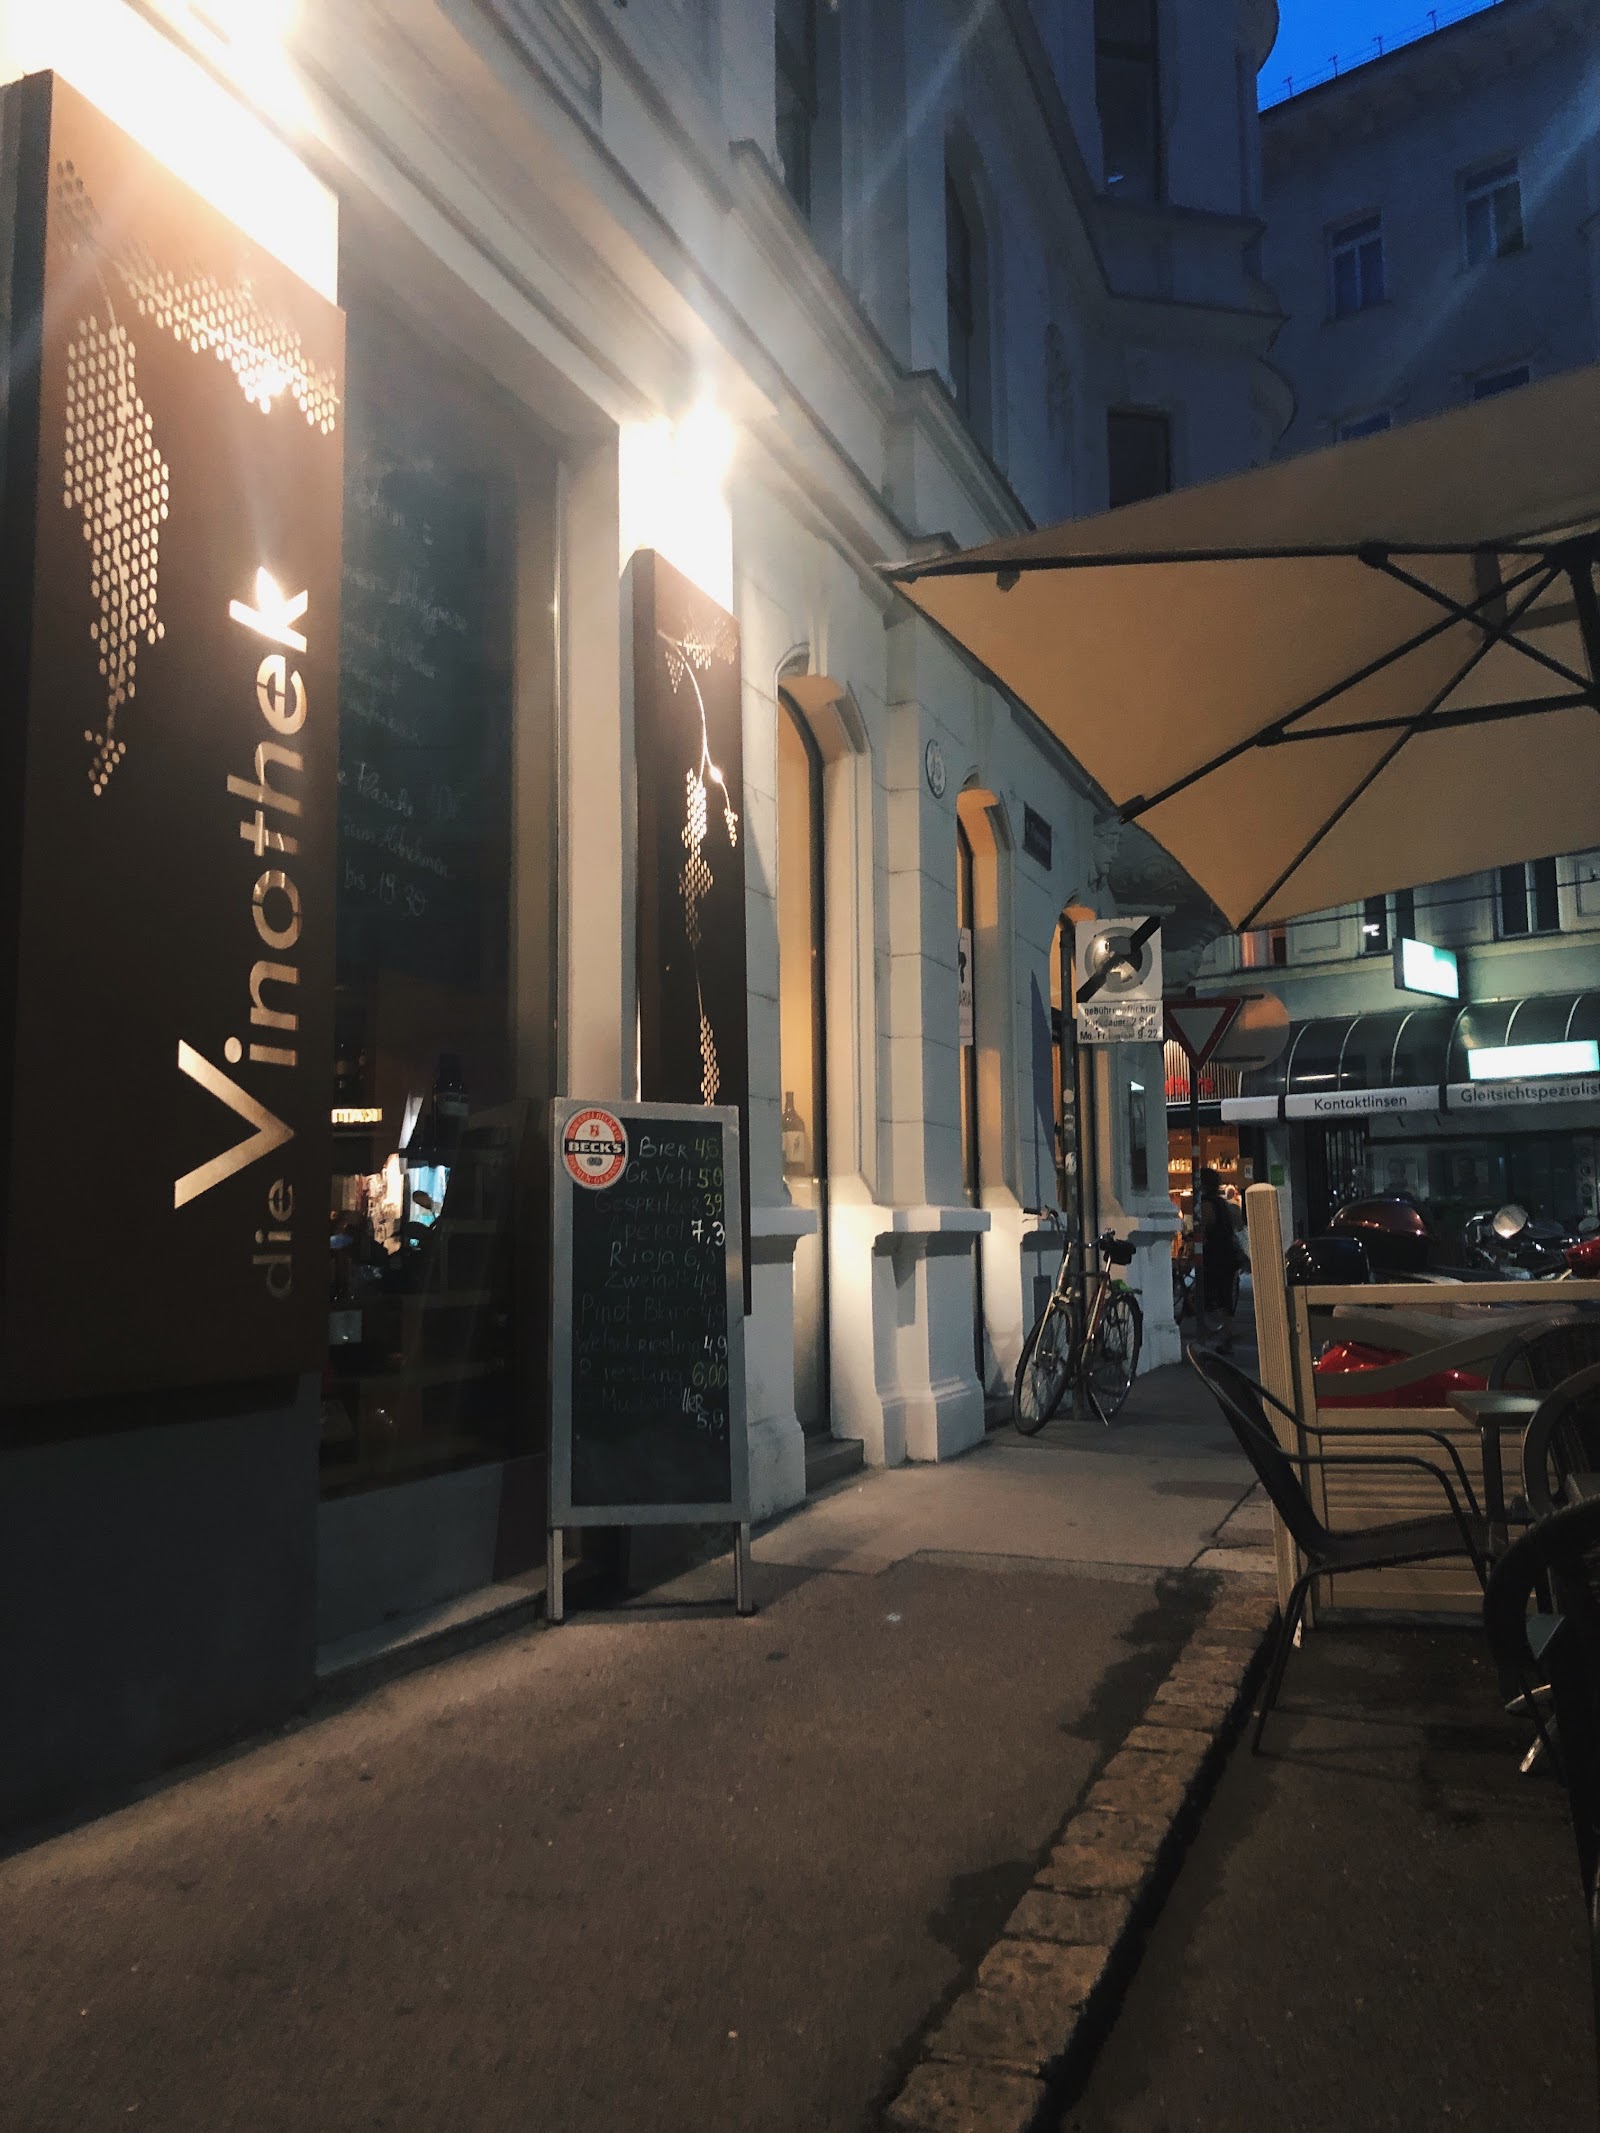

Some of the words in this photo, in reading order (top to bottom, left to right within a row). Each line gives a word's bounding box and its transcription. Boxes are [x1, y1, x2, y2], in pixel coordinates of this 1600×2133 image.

[174, 565, 308, 1210] Vinothek
[1314, 1094, 1408, 1112] Kontaktlinsen
[568, 1141, 622, 1153] BECK'S
[252, 1177, 295, 1298] die
[691, 1219, 726, 1247] 7,3
[610, 1241, 676, 1272] Rioja
